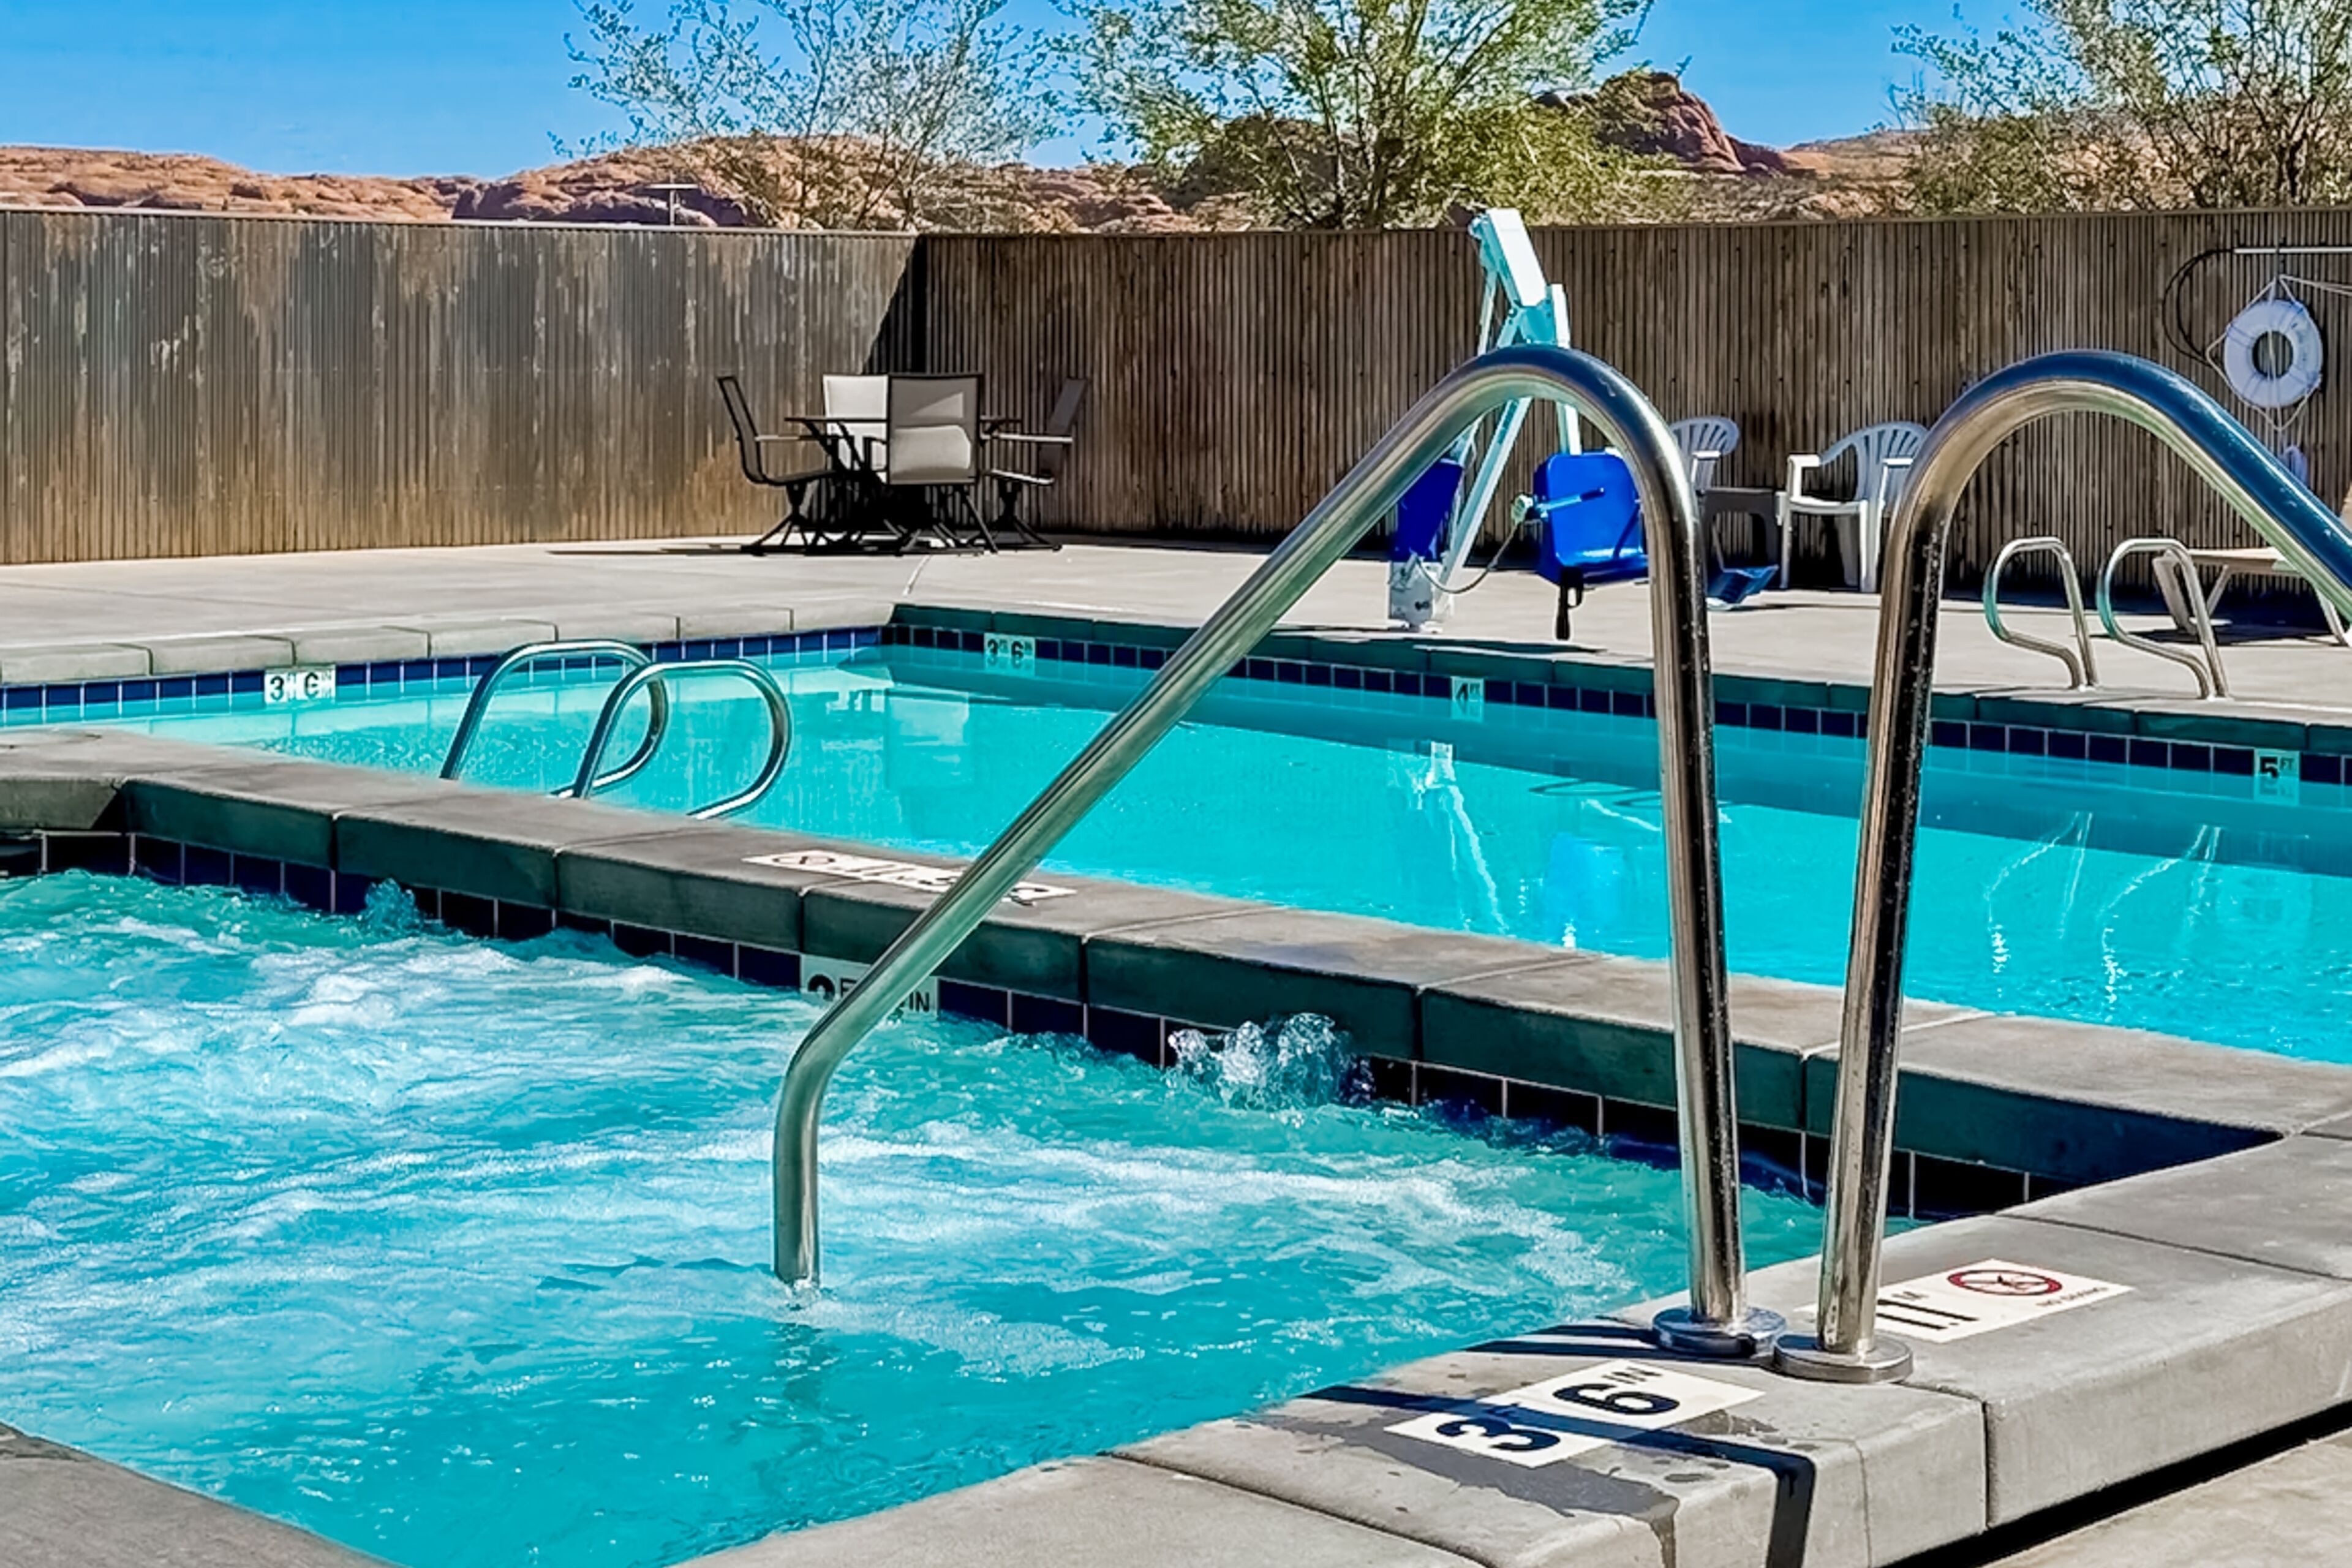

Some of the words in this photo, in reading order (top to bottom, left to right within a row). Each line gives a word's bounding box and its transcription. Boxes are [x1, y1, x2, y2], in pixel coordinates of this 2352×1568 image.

[270, 676, 284, 700] 3
[2259, 756, 2279, 778] 5
[1436, 1417, 1561, 1452] 3
[1553, 1383, 1681, 1415] 6
